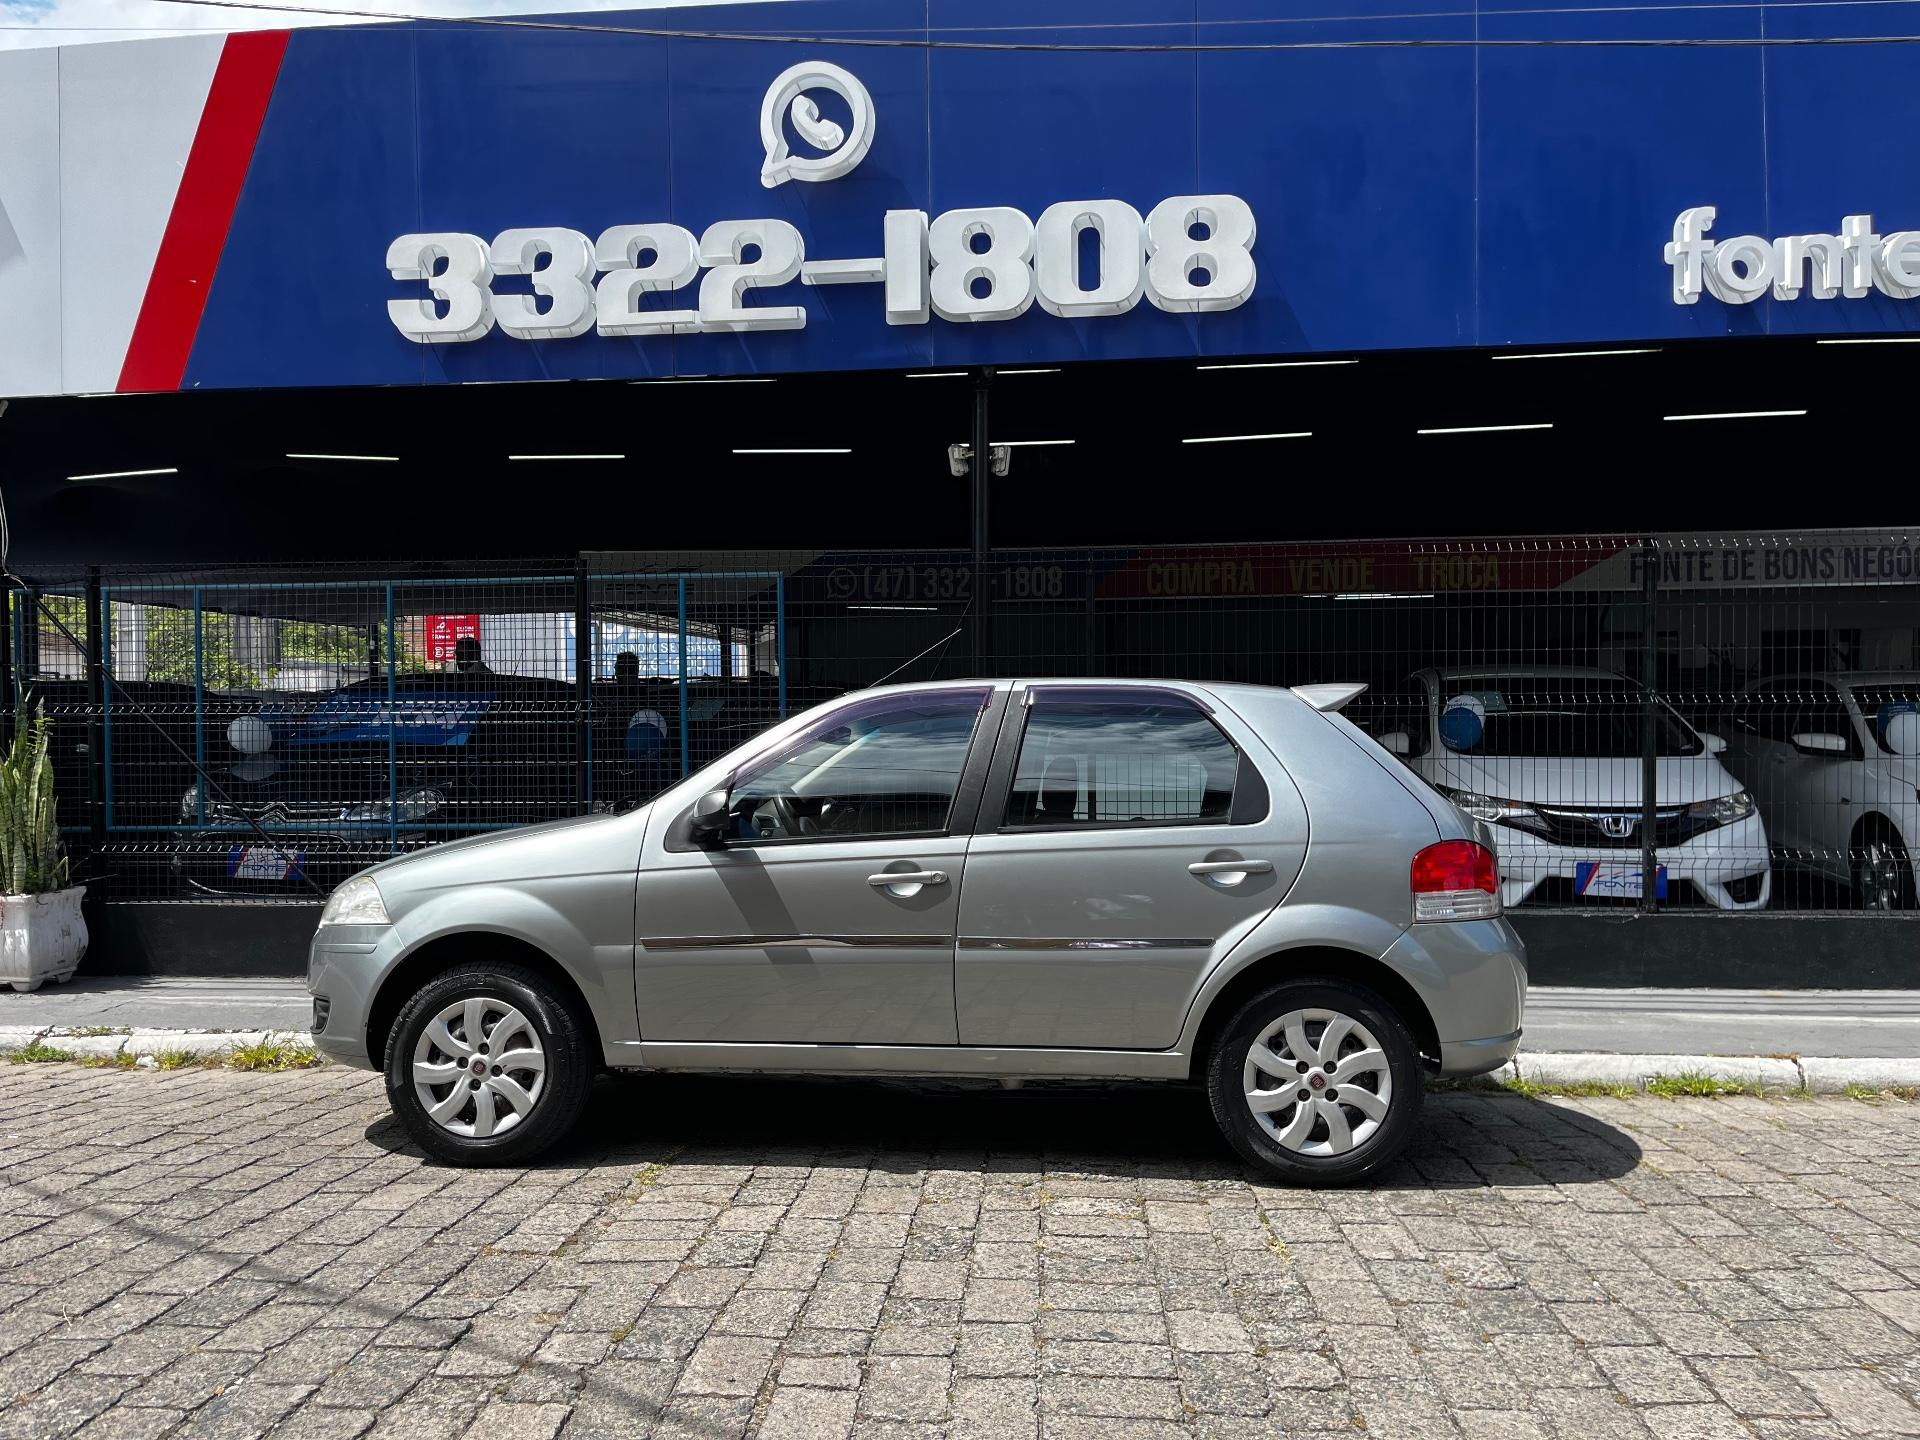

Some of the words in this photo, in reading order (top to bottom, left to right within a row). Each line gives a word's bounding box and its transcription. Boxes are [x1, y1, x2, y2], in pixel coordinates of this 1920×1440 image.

[387, 194, 1258, 344] 3322-1808
[863, 566, 918, 600] (47)
[923, 565, 985, 599] 332
[1004, 565, 1063, 597] 1808
[1146, 561, 1256, 595] COMPRA
[1289, 558, 1377, 592] VENDE
[1413, 555, 1501, 590] TROCA
[1723, 549, 1756, 581] DE
[1764, 547, 1835, 580] BONS
